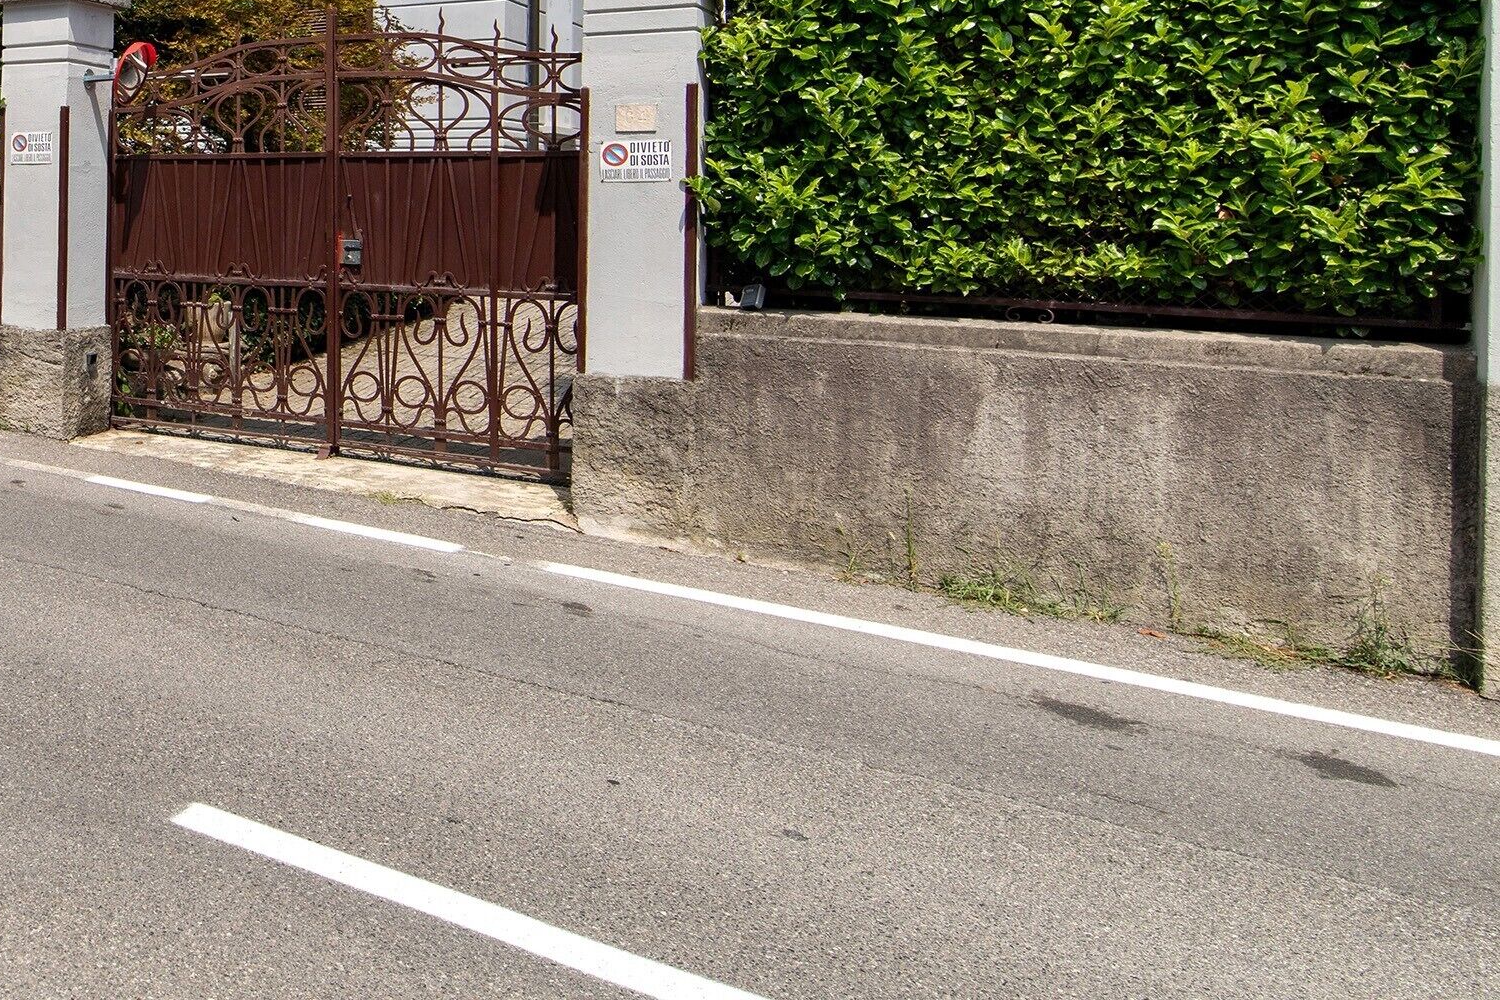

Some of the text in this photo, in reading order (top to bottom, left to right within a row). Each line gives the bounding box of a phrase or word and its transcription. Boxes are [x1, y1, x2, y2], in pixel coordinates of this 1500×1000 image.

[28, 133, 51, 142] DIVIETO
[28, 143, 51, 152] DI SOSTA
[630, 141, 670, 153] DIVIETO
[630, 154, 670, 166] DI SOSTA
